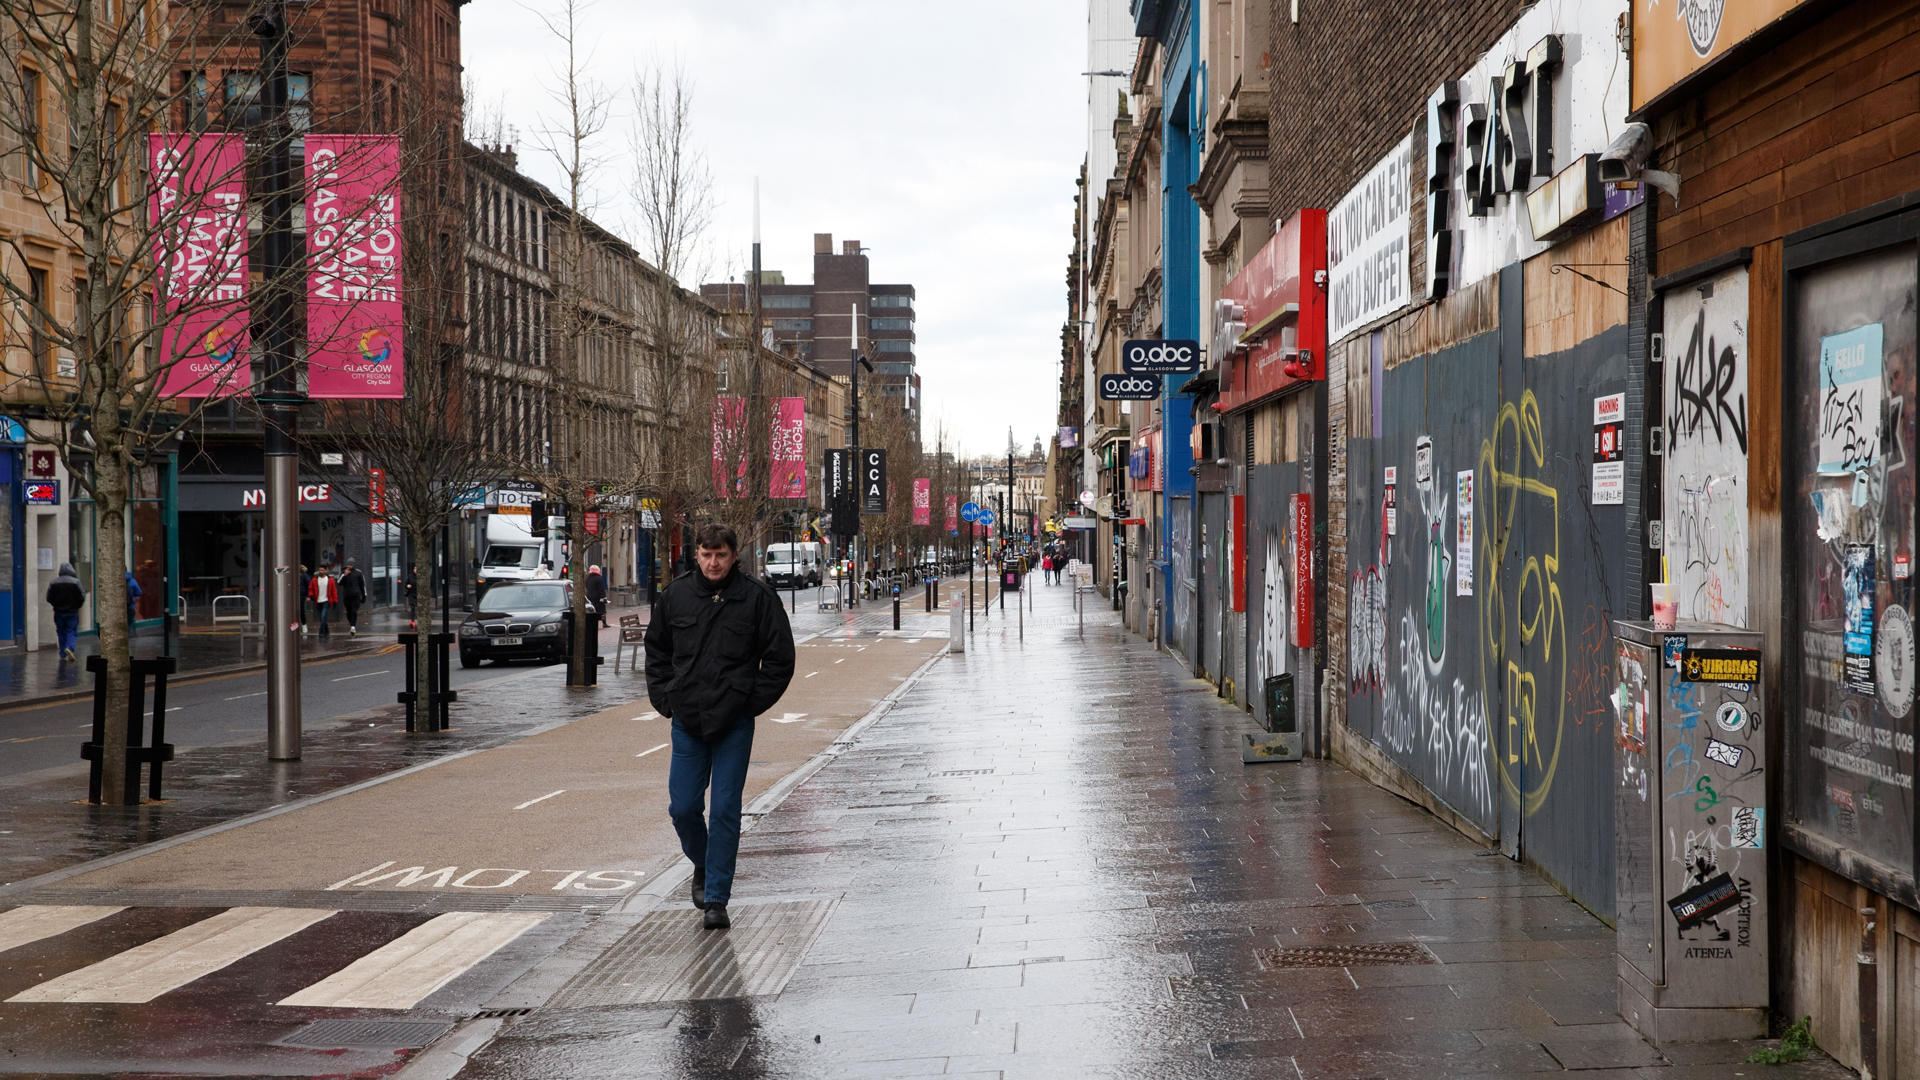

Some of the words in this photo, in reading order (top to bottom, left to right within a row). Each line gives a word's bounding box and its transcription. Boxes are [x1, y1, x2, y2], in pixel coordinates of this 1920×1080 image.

[312, 148, 340, 302] GLASGOW
[1330, 213, 1343, 271] ALL
[1344, 191, 1362, 257] YOU
[1364, 170, 1386, 240] CAN
[1388, 148, 1410, 224] EAT
[342, 218, 370, 301] MAKE
[370, 194, 396, 301] PEOPLE
[1334, 265, 1361, 333] WORLD
[1364, 234, 1404, 315] BUFFET
[1835, 344, 1865, 372] HELLO
[1598, 398, 1618, 415] WARNING
[782, 428, 792, 461] MAKE
[792, 420, 803, 461] PEOPLE
[500, 493, 516, 503] TO
[1805, 657, 1820, 680] ALL
[326, 860, 646, 891] SLOW
[1684, 948, 1733, 958] ATENEA
